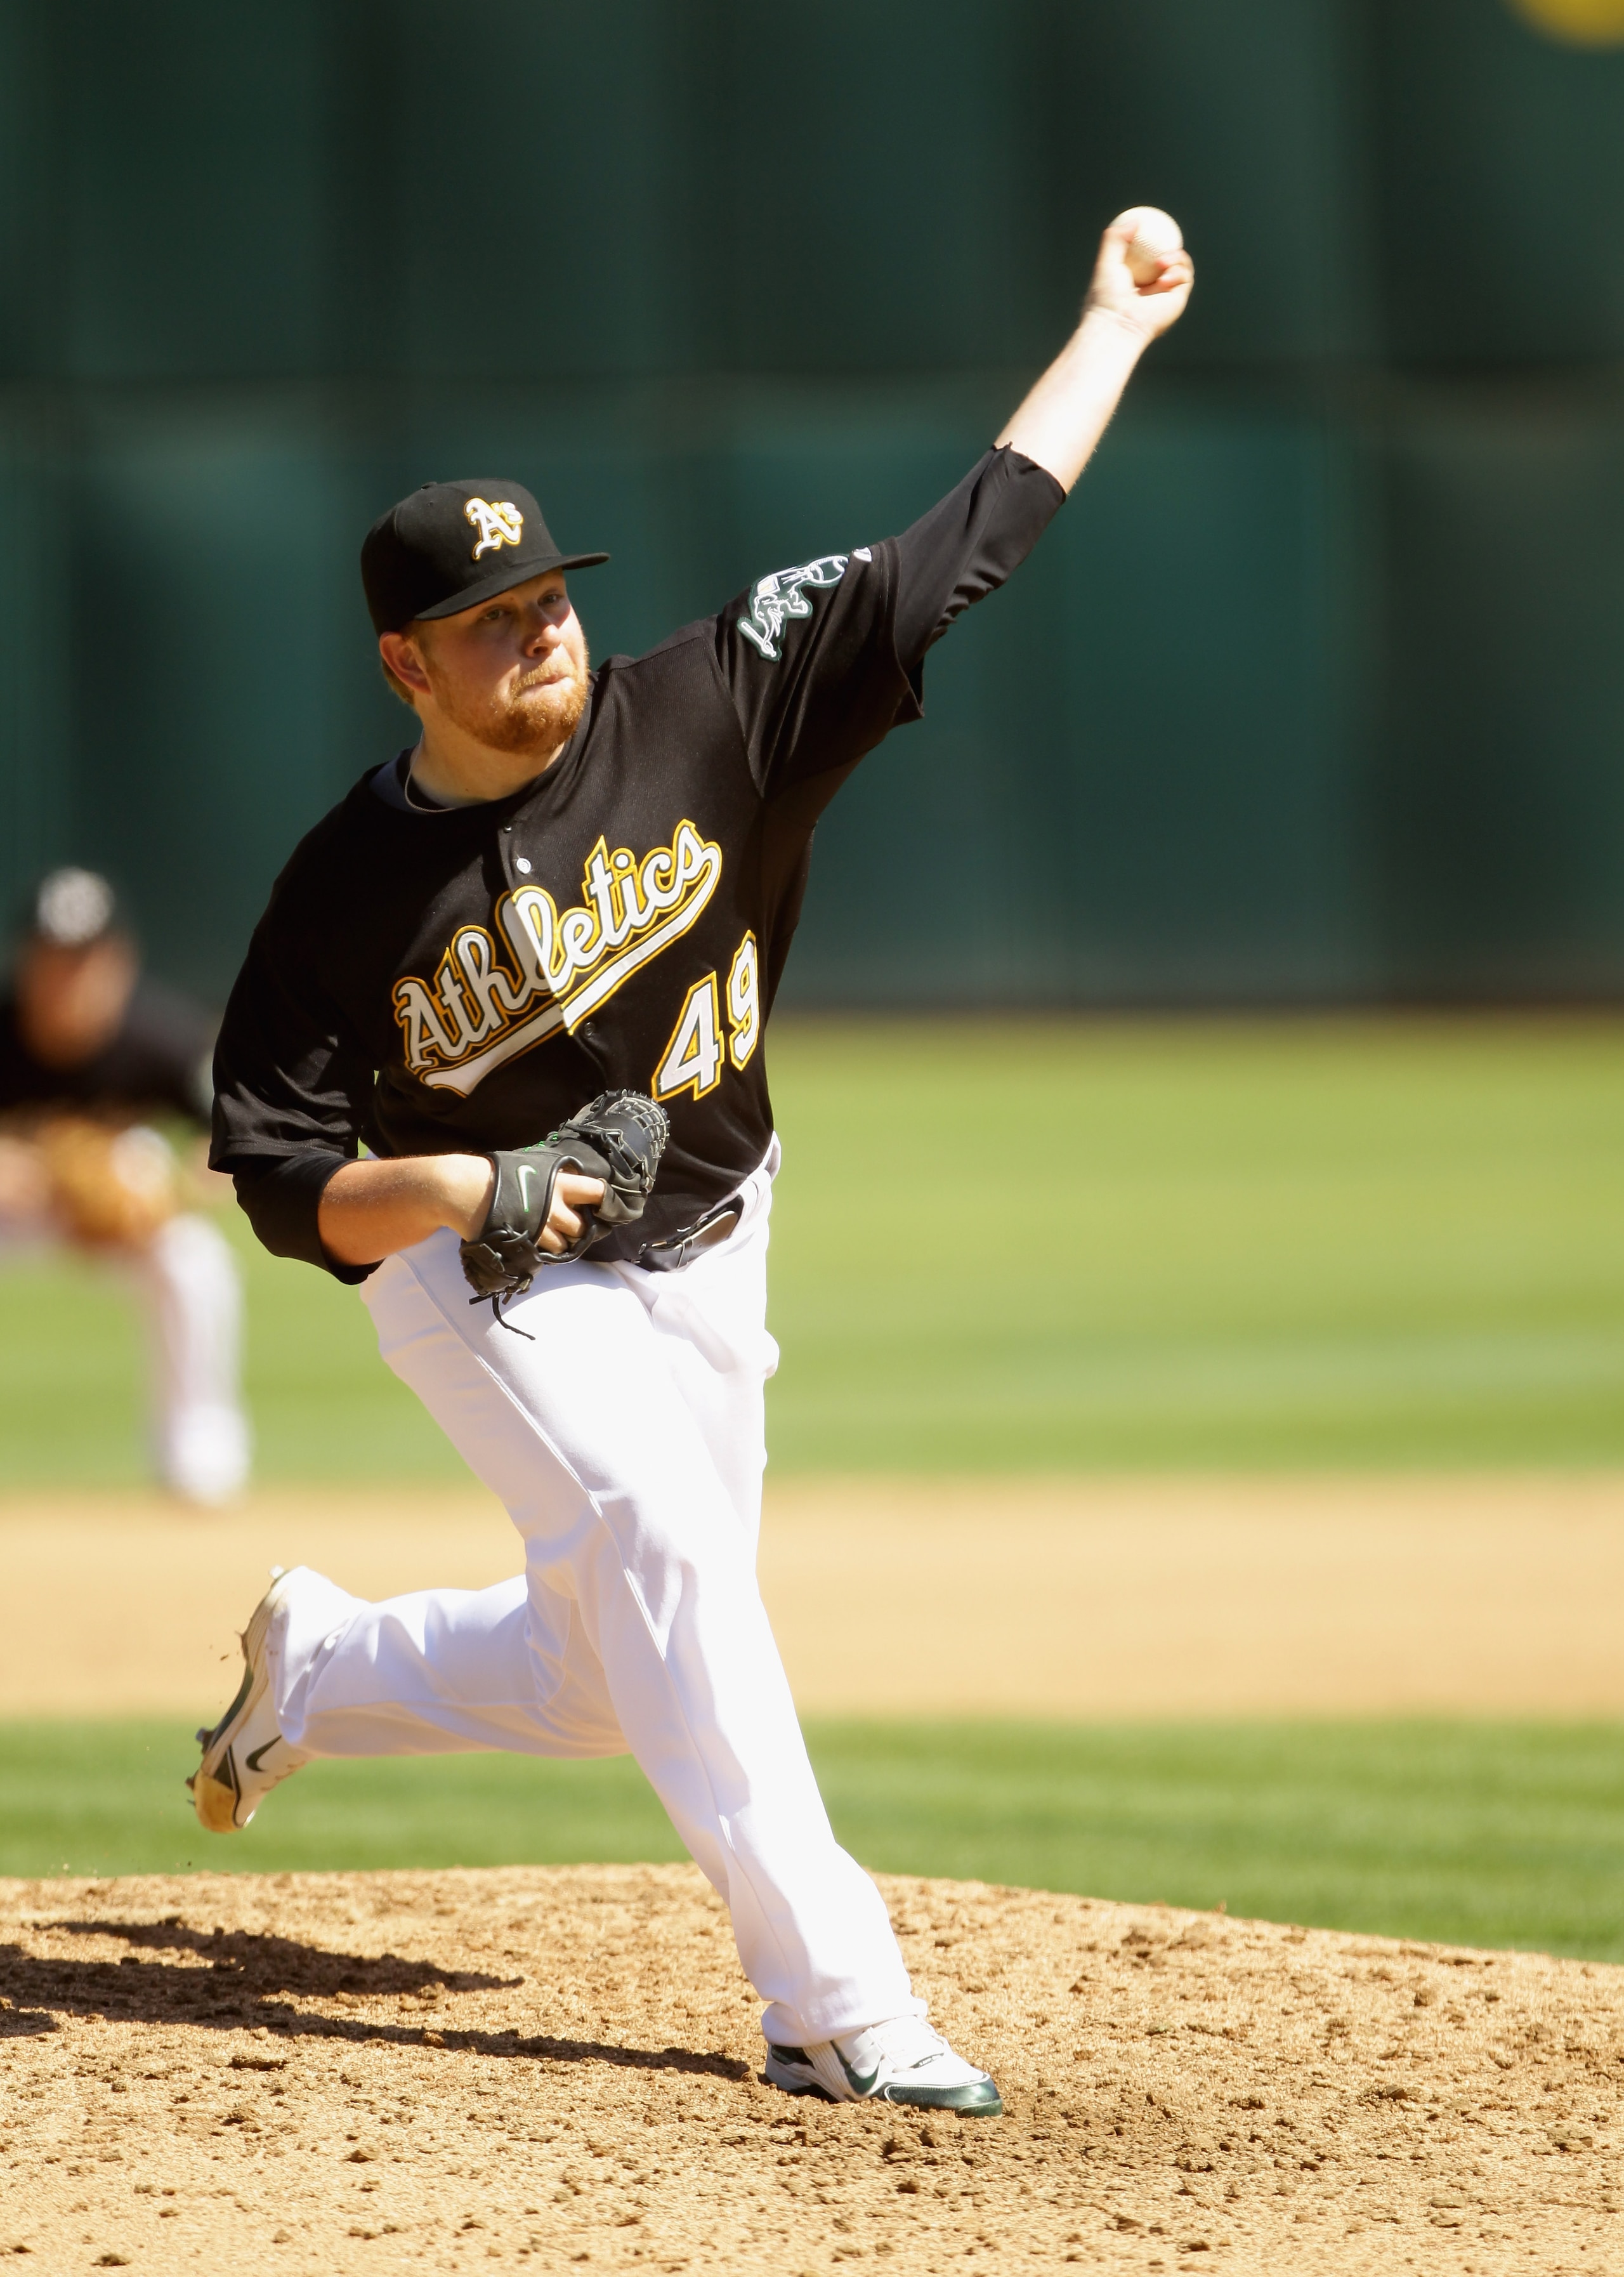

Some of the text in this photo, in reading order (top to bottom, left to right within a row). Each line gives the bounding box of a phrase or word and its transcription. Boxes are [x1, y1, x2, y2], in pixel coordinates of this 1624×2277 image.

[464, 497, 523, 560] A's
[391, 819, 722, 1073] Athletics
[652, 929, 759, 1101] 49
